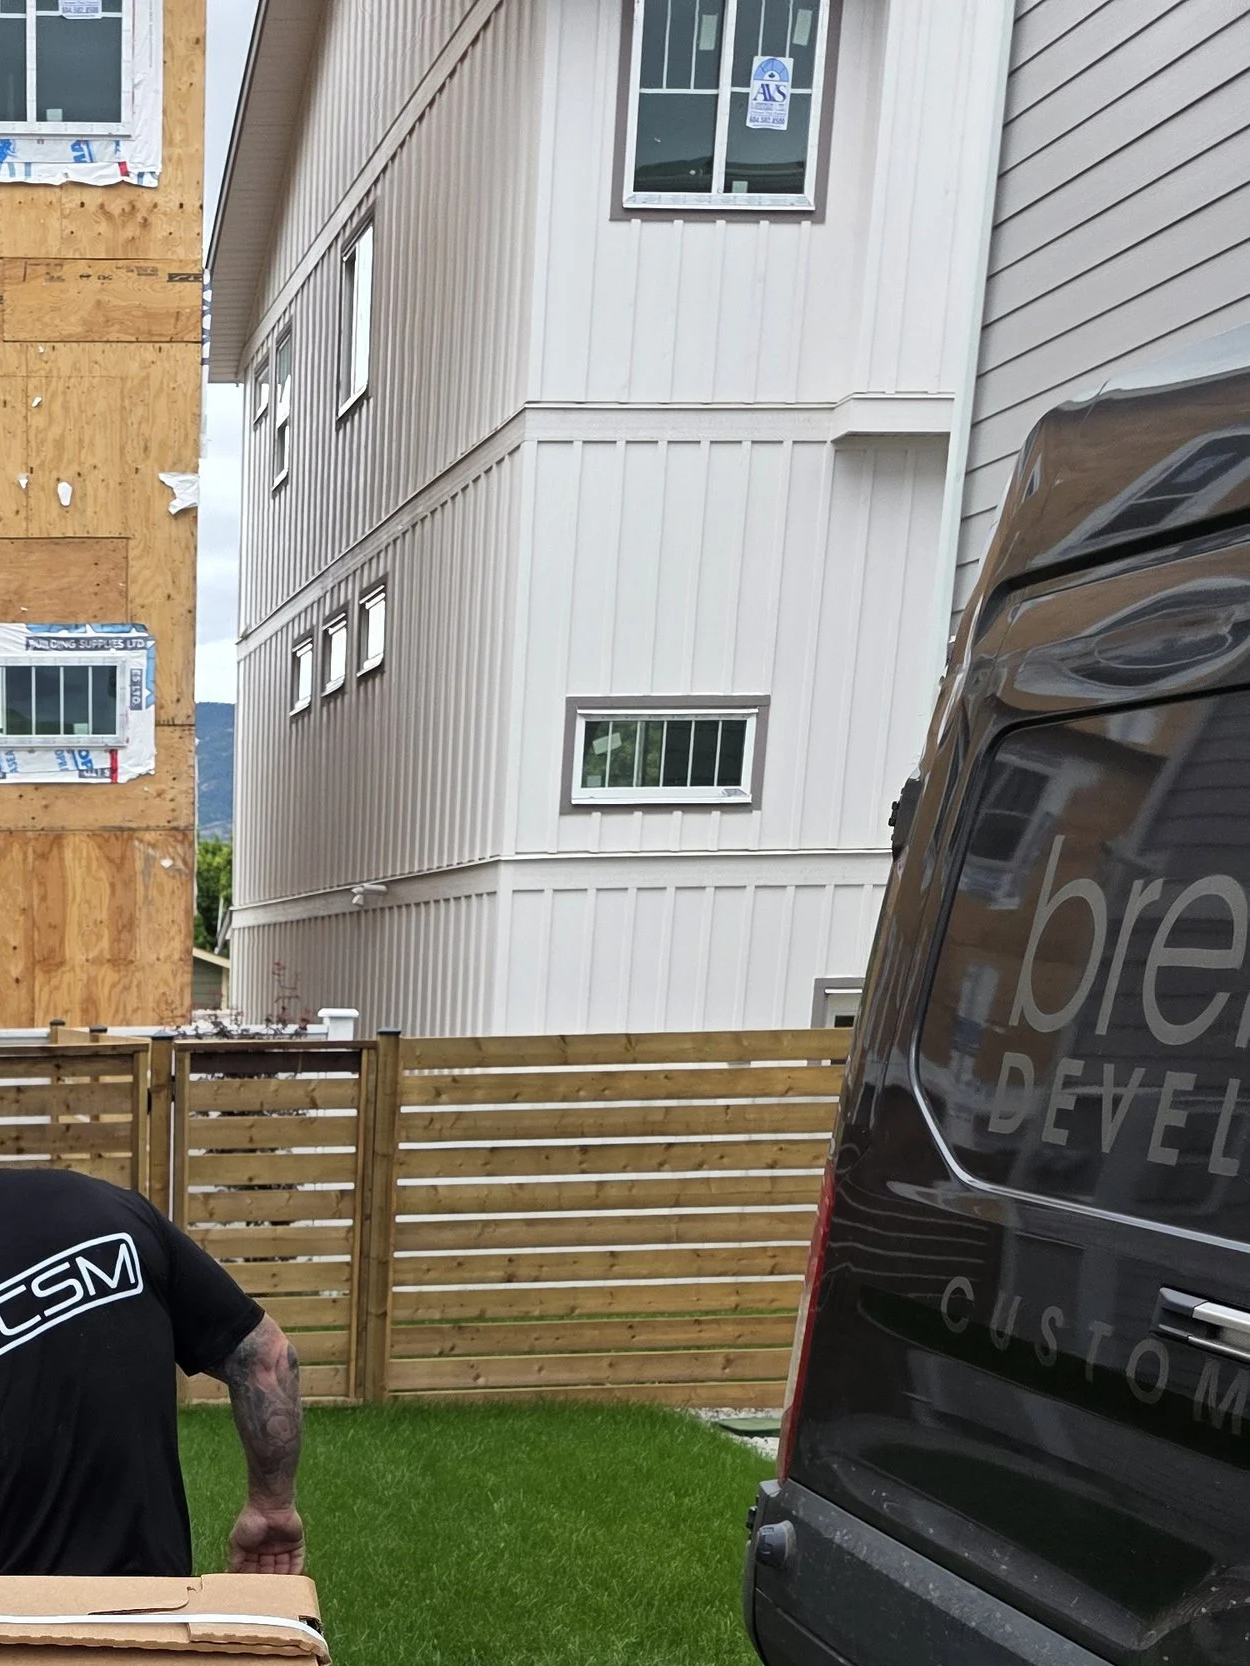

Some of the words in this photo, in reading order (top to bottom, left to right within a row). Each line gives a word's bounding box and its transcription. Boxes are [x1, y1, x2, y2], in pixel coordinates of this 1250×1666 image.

[79, 639, 125, 650] SUPPLIES
[987, 1051, 1243, 1178] DEVEL
[940, 1275, 1250, 1435] CUSTOM
